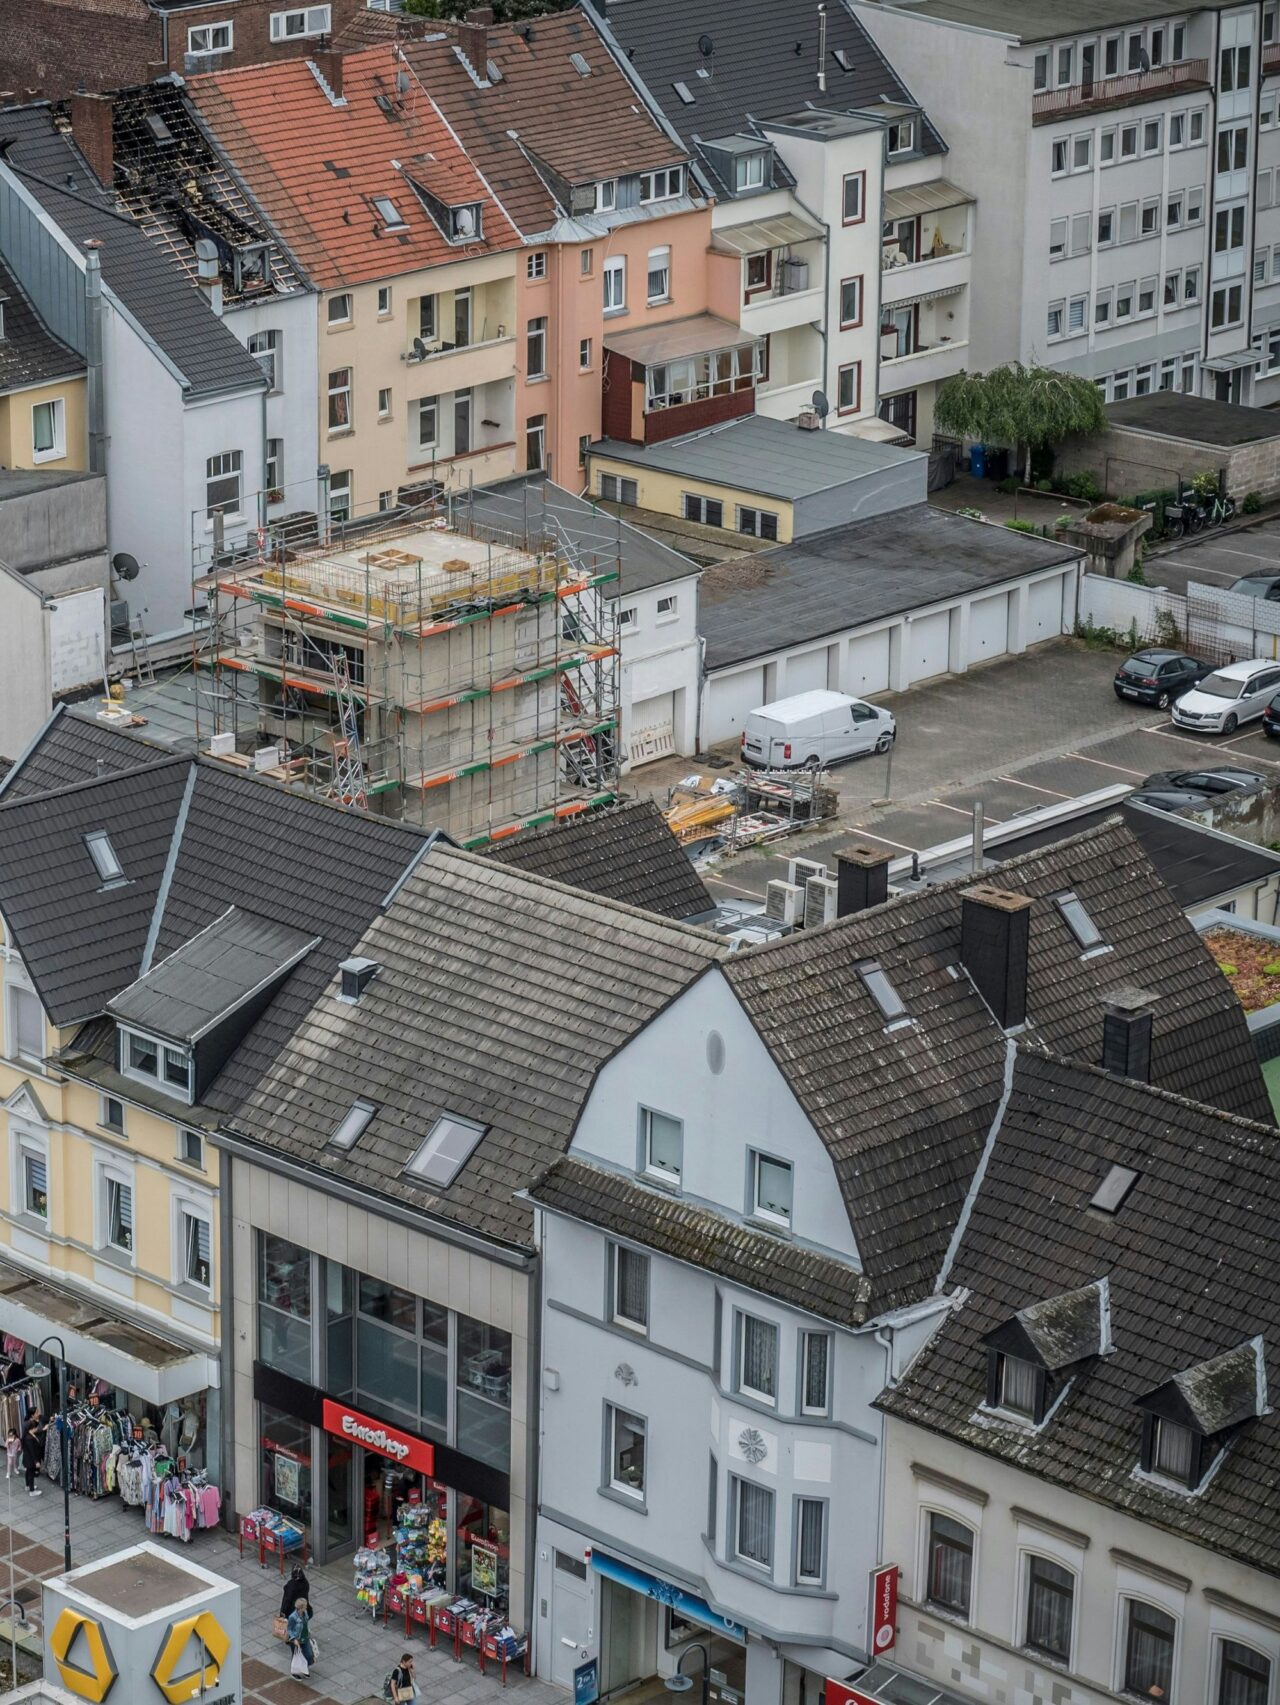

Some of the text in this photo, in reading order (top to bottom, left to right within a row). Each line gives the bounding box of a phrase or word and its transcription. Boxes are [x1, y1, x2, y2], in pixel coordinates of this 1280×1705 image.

[316, 608, 333, 619] PAUL
[241, 663, 258, 674] PAUL
[448, 770, 464, 780] PAUL
[514, 821, 529, 831] PAUL
[883, 1575, 891, 1621] vodafone
